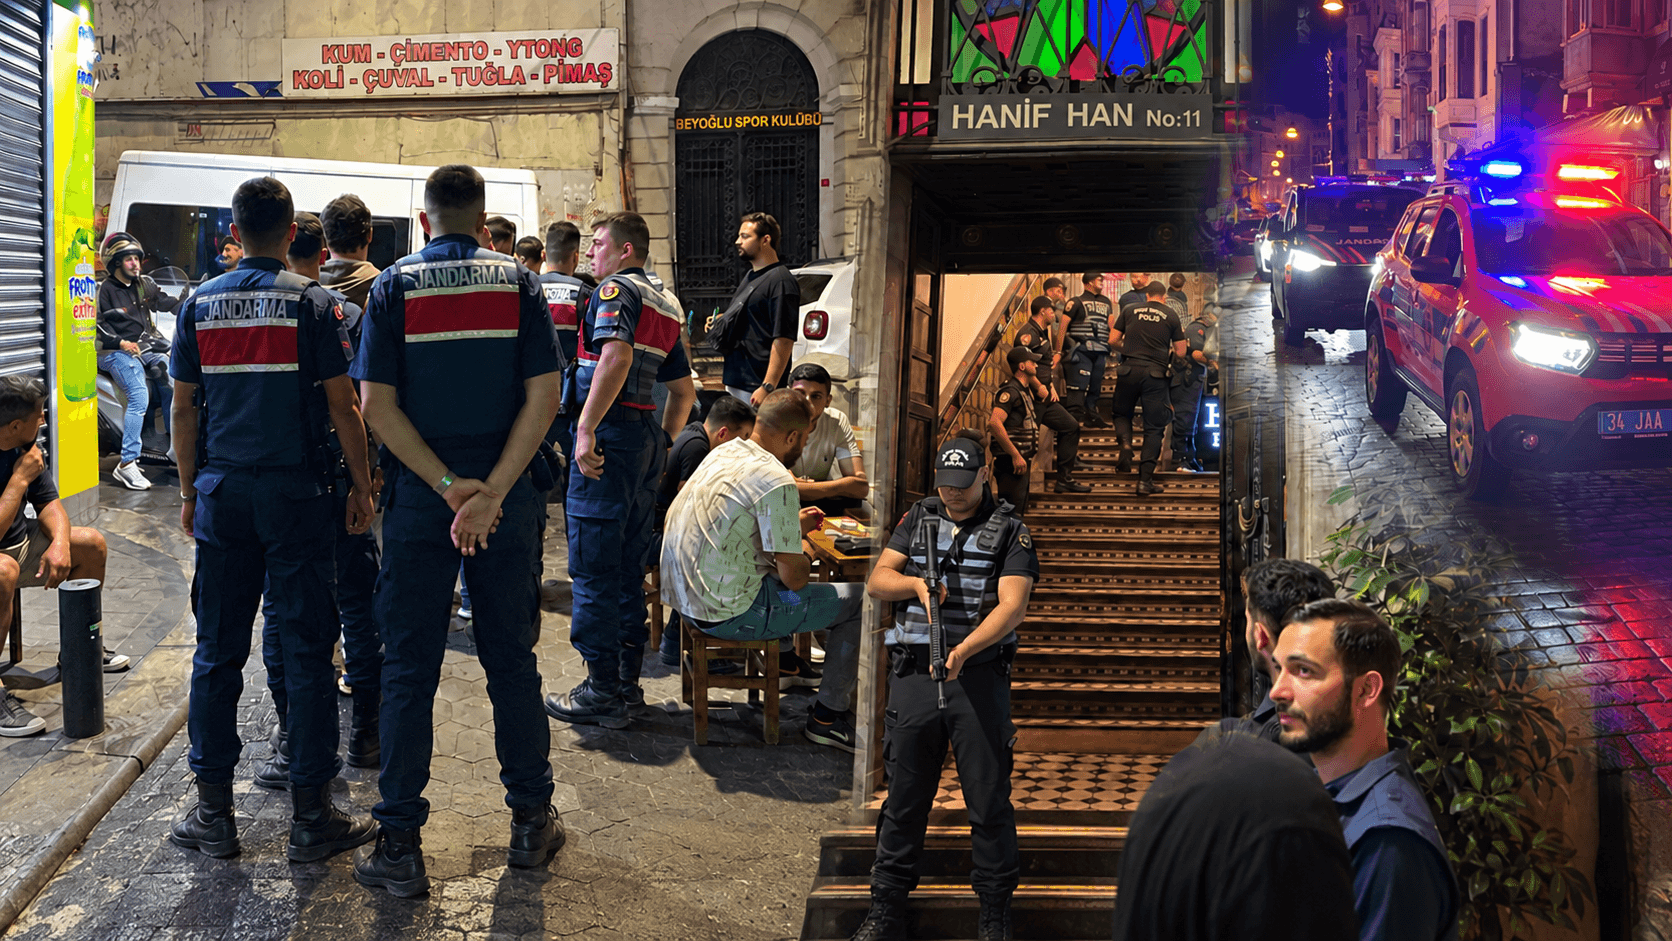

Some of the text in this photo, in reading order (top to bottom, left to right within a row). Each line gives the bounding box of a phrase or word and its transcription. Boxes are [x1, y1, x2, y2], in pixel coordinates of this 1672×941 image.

[322, 44, 371, 64] KUM
[390, 38, 488, 67] ÇİMENTO
[505, 37, 583, 59] YTONG
[292, 65, 344, 89] KOLİ
[362, 67, 434, 94] ÇUVAL
[451, 61, 526, 87] TUĞLA
[543, 59, 612, 88] PİMAŞ
[676, 114, 732, 130] BEYOĞLU
[735, 115, 769, 128] SPOR
[952, 97, 1201, 129] HANİF HAN No:11
[415, 265, 508, 289] JANDARMA
[204, 299, 287, 321] JANDARMA
[1607, 411, 1663, 431] 34 JAA
